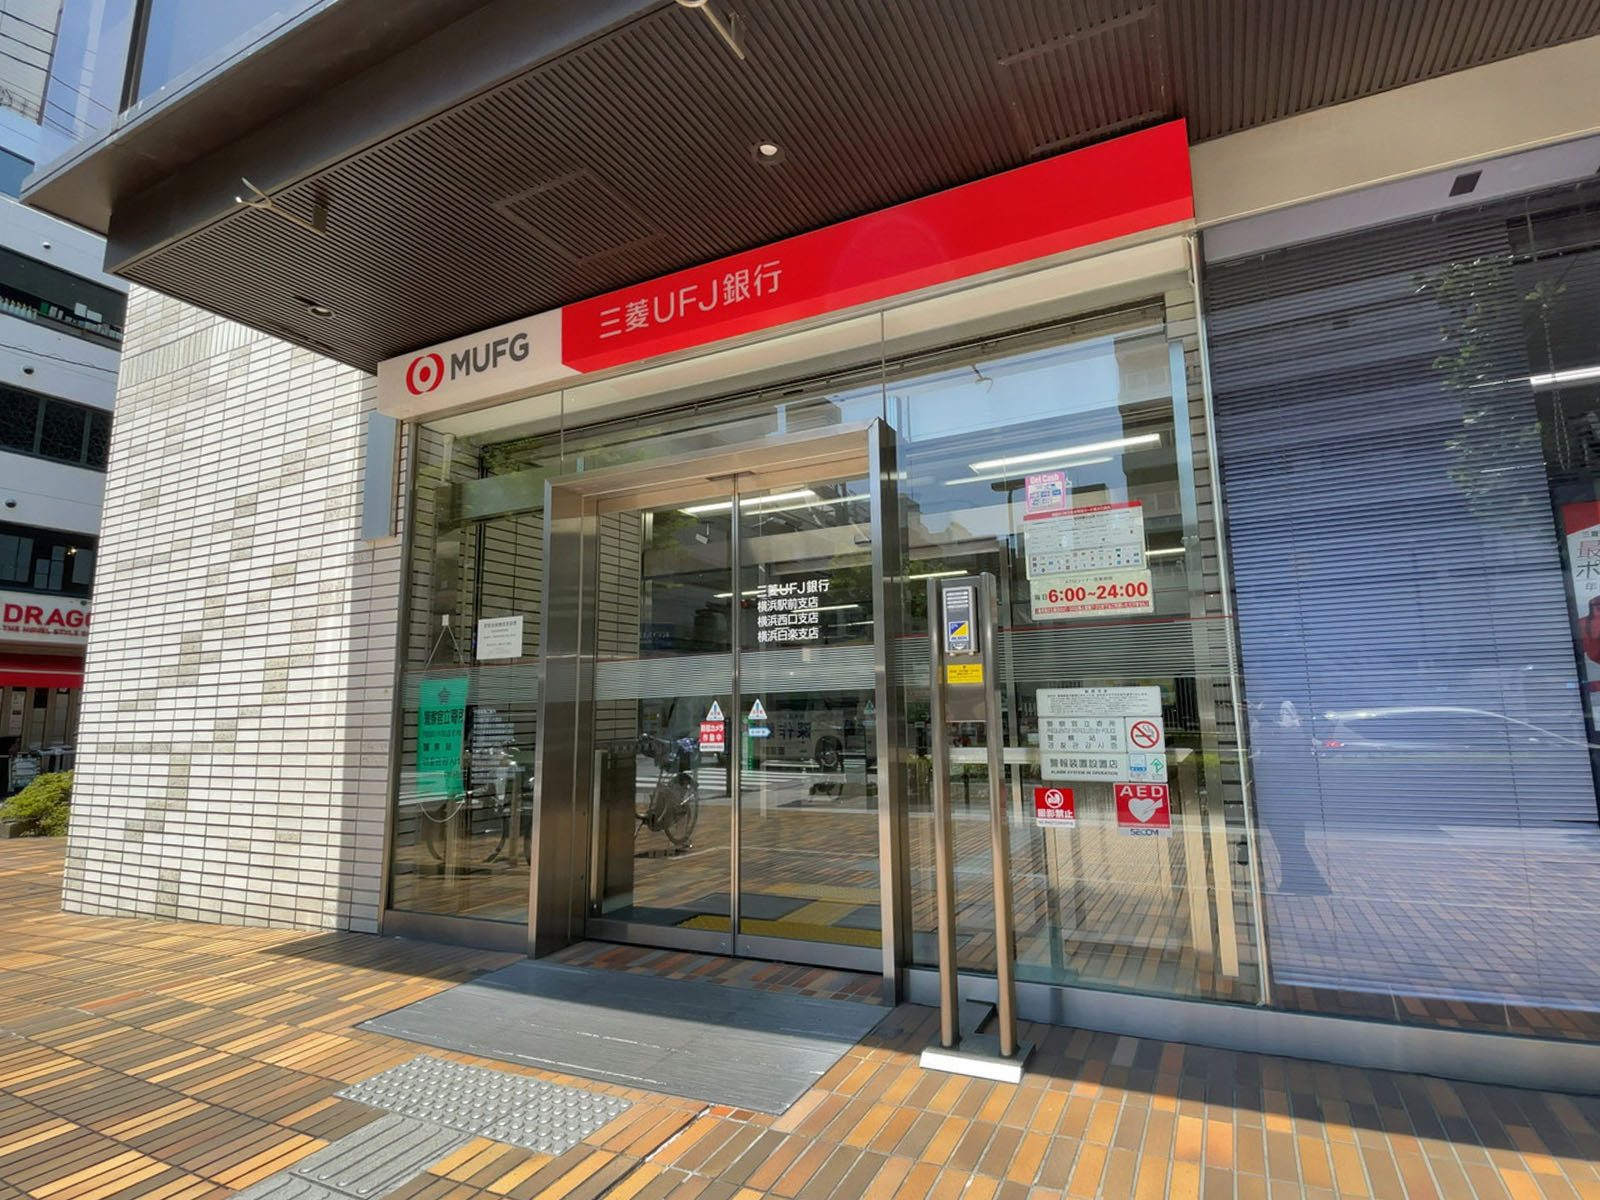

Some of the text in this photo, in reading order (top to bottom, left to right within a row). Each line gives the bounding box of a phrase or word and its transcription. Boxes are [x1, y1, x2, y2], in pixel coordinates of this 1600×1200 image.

[600, 260, 782, 339] 三菱UFJ銀行
[450, 332, 530, 380] MUFG
[756, 579, 830, 598] 三菱UFJ銀行
[757, 597, 819, 613] 横浜駅前支店
[757, 612, 819, 628] 横浜西口支店
[757, 627, 819, 643] 横浜白楽支店
[1119, 785, 1164, 798] AED
